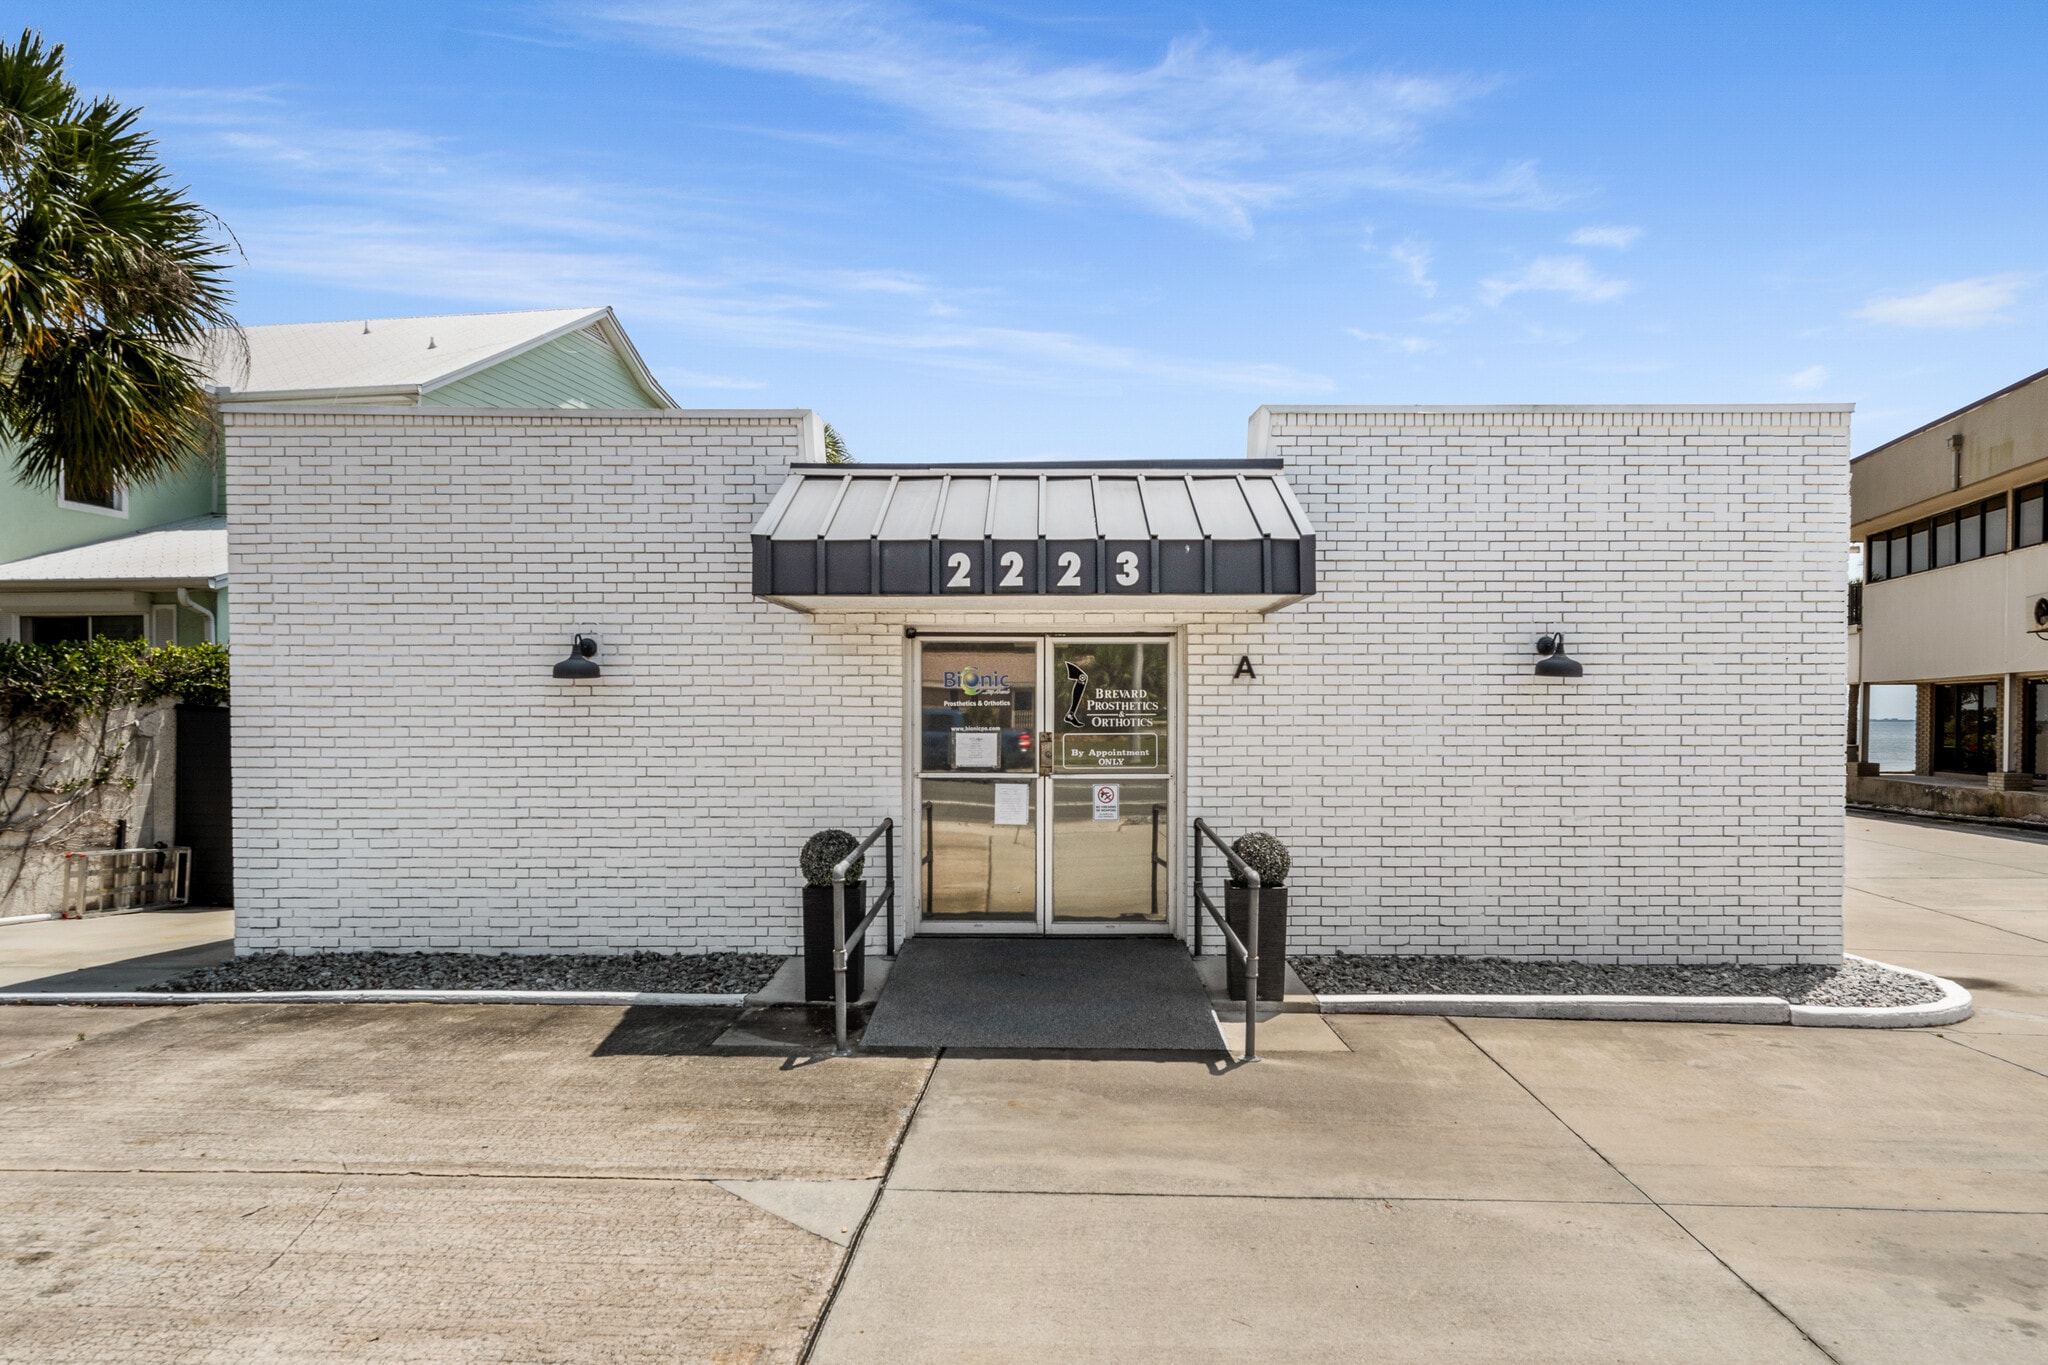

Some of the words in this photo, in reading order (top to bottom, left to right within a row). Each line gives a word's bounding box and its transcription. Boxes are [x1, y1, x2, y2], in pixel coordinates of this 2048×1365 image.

[946, 550, 1140, 588] 2223
[1233, 655, 1257, 679] A
[944, 669, 1010, 689] Bionic
[1095, 688, 1147, 699] BREVARD
[1087, 700, 1159, 711] PROSTHETICS
[1092, 717, 1154, 727] ORTHOTICS
[1071, 749, 1084, 757] By
[1089, 749, 1150, 757] Appointment
